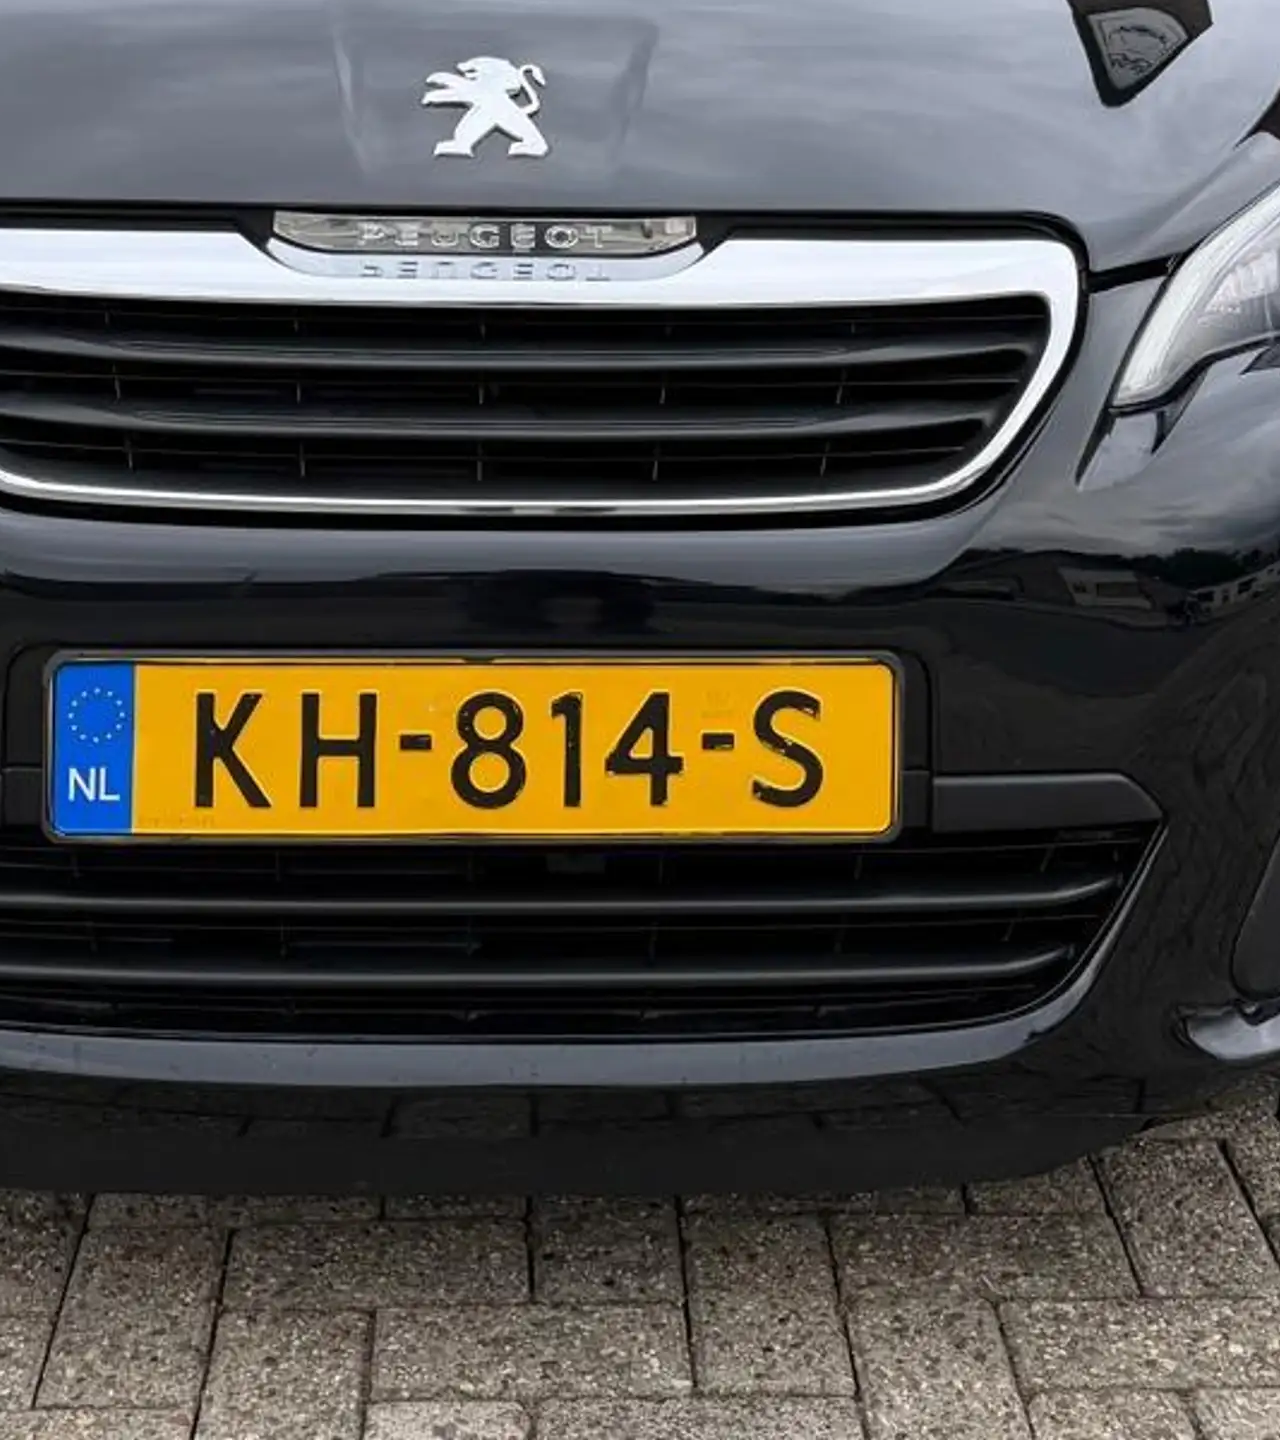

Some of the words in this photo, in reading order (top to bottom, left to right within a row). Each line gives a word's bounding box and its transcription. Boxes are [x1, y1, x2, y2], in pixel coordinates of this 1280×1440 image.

[357, 222, 613, 250] PEUGEOT
[193, 690, 824, 809] KH-814-S
[68, 768, 120, 803] NL
